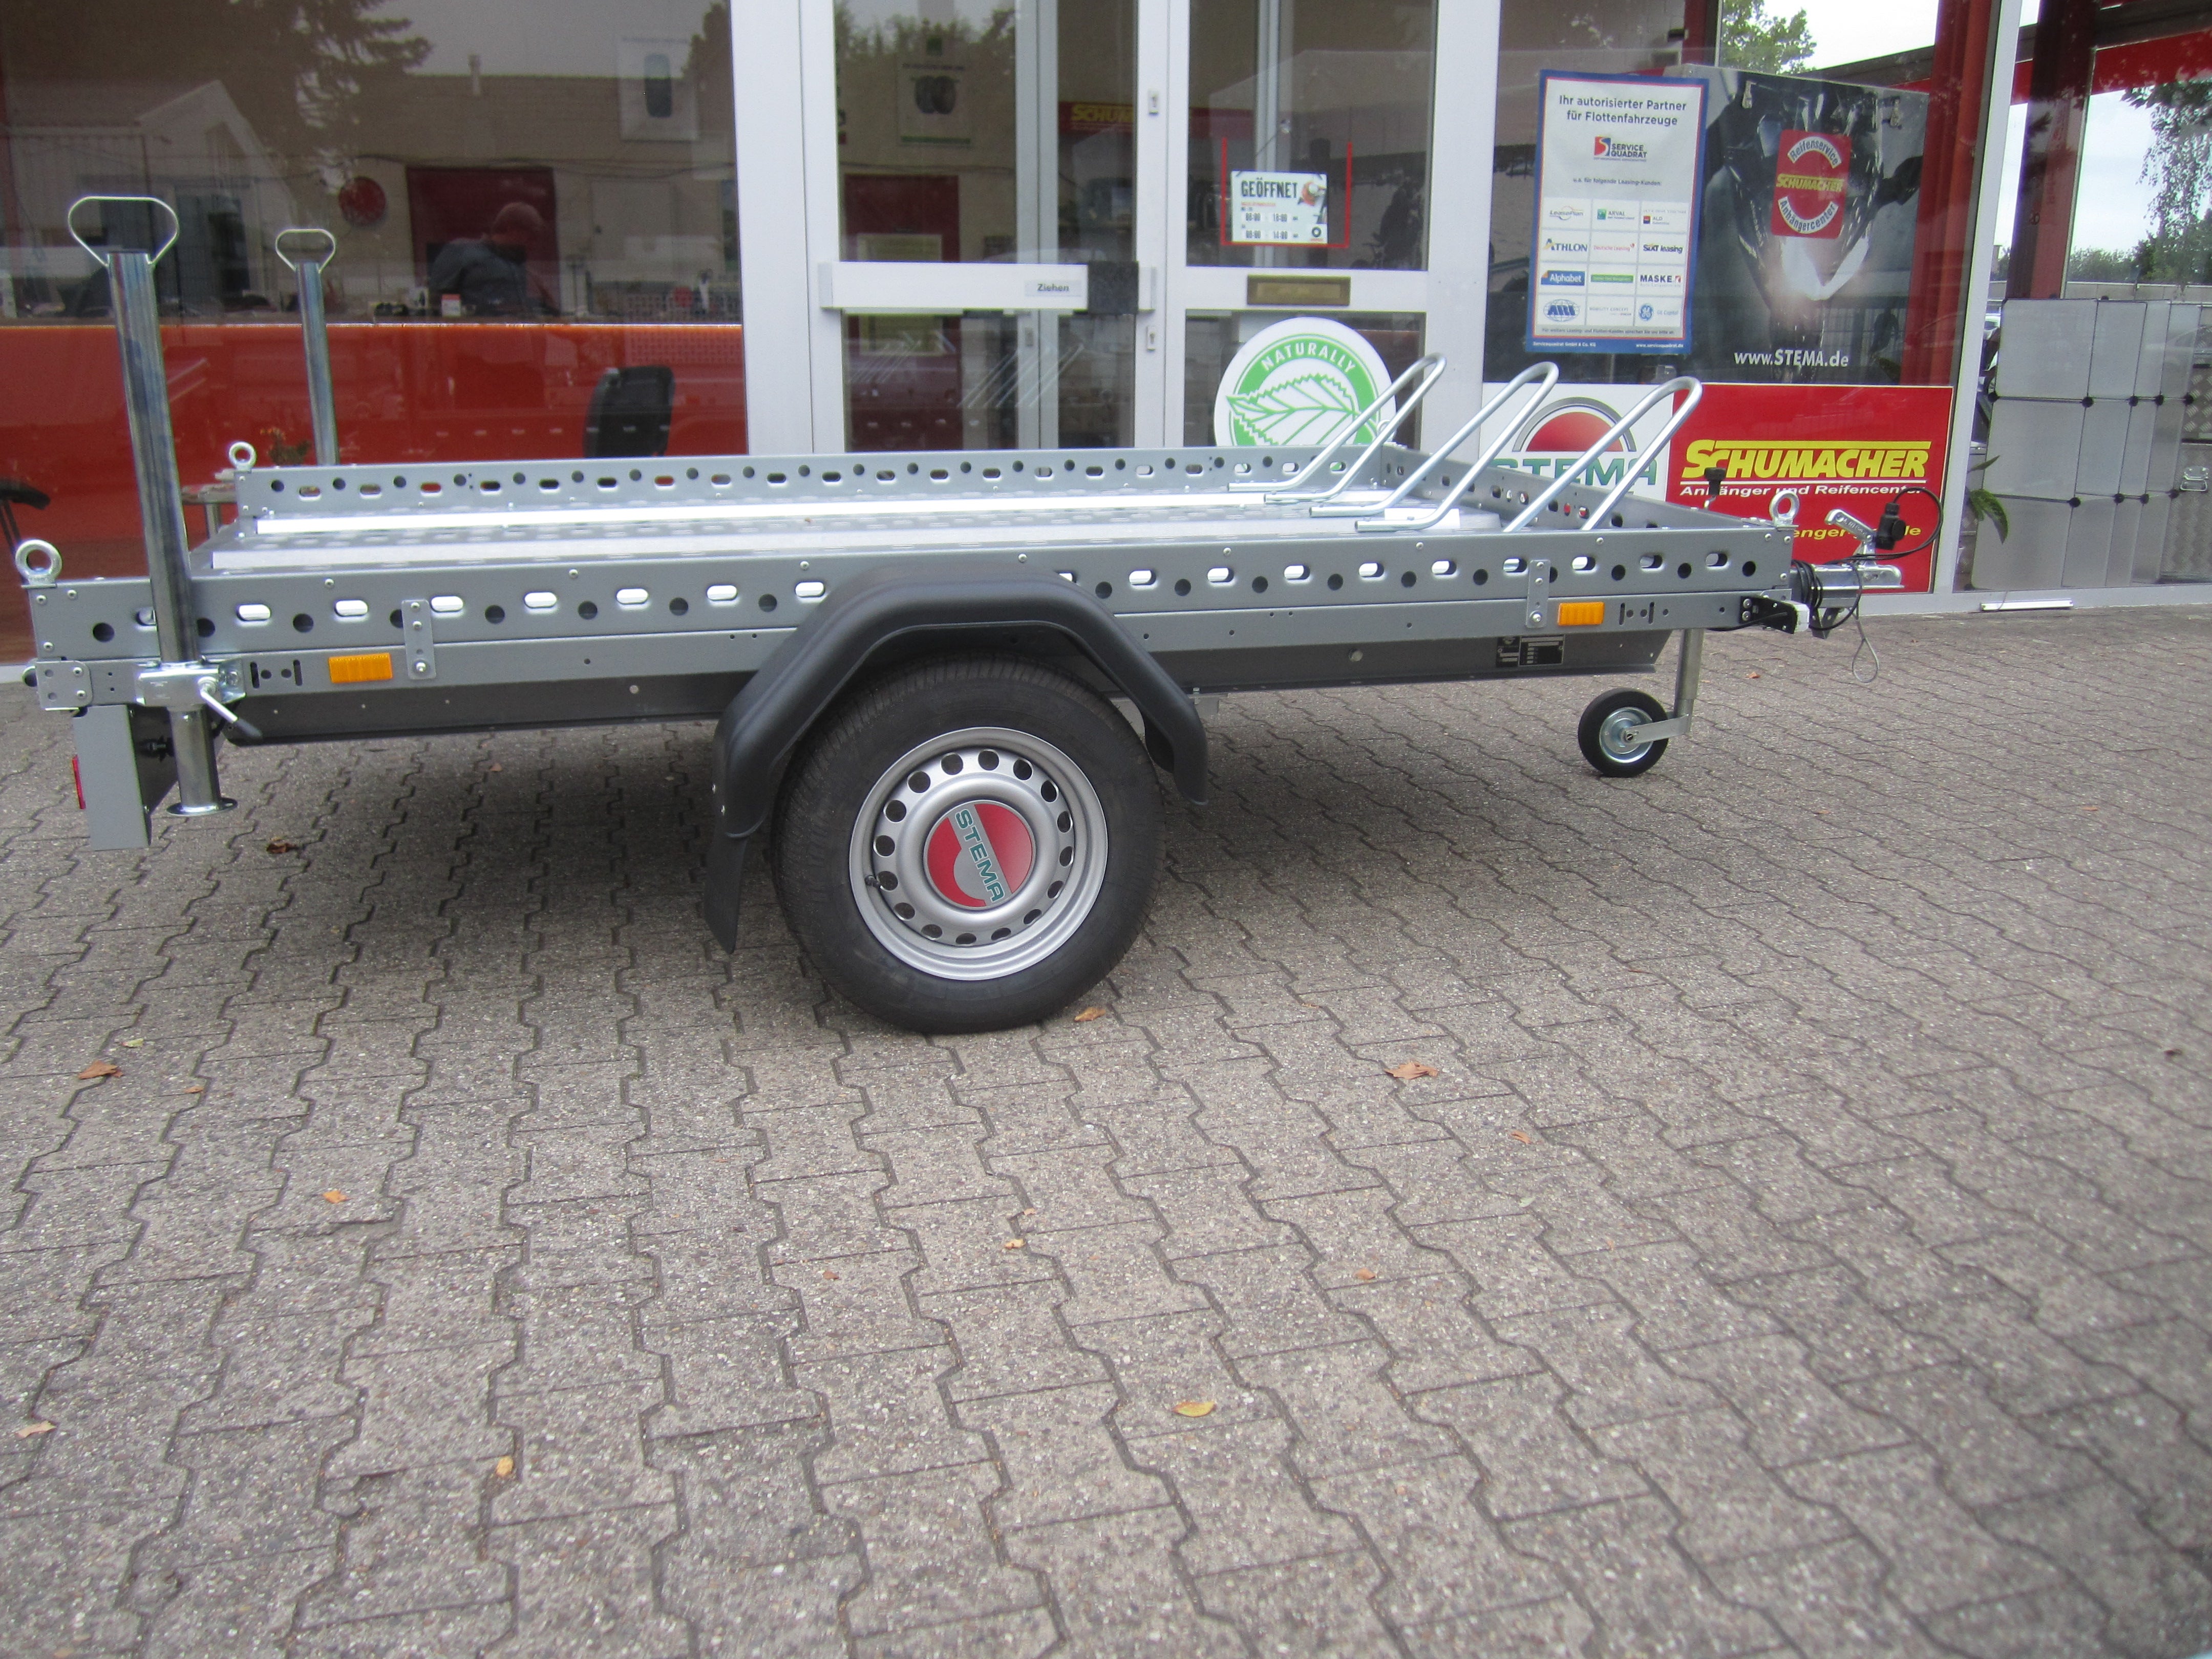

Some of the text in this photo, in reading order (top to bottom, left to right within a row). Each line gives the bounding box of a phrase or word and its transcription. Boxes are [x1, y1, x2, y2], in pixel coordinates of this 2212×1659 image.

[1559, 95, 1687, 111] Ihr autorisierter Partner
[1567, 110, 1678, 127] für Flottenfahrzeuge
[1611, 143, 1644, 151] SERVICE
[1611, 150, 1647, 158] QUADRAT
[1790, 139, 1839, 166] Reifenservice
[1241, 177, 1298, 199] GEÖFFNET
[1776, 173, 1844, 192] SCHUMACHER
[1780, 200, 1836, 232] Anhängercenter
[1545, 238, 1588, 251] ATHLON
[1660, 245, 1683, 254] leasing
[1550, 273, 1582, 284] Alphabet
[1640, 274, 1672, 283] MASKE
[1261, 341, 1357, 373] NATURALLY
[1734, 349, 1849, 367] www.STEMA.de
[1682, 439, 1932, 479] SCHUMACHER
[955, 808, 1006, 903] STEMA
